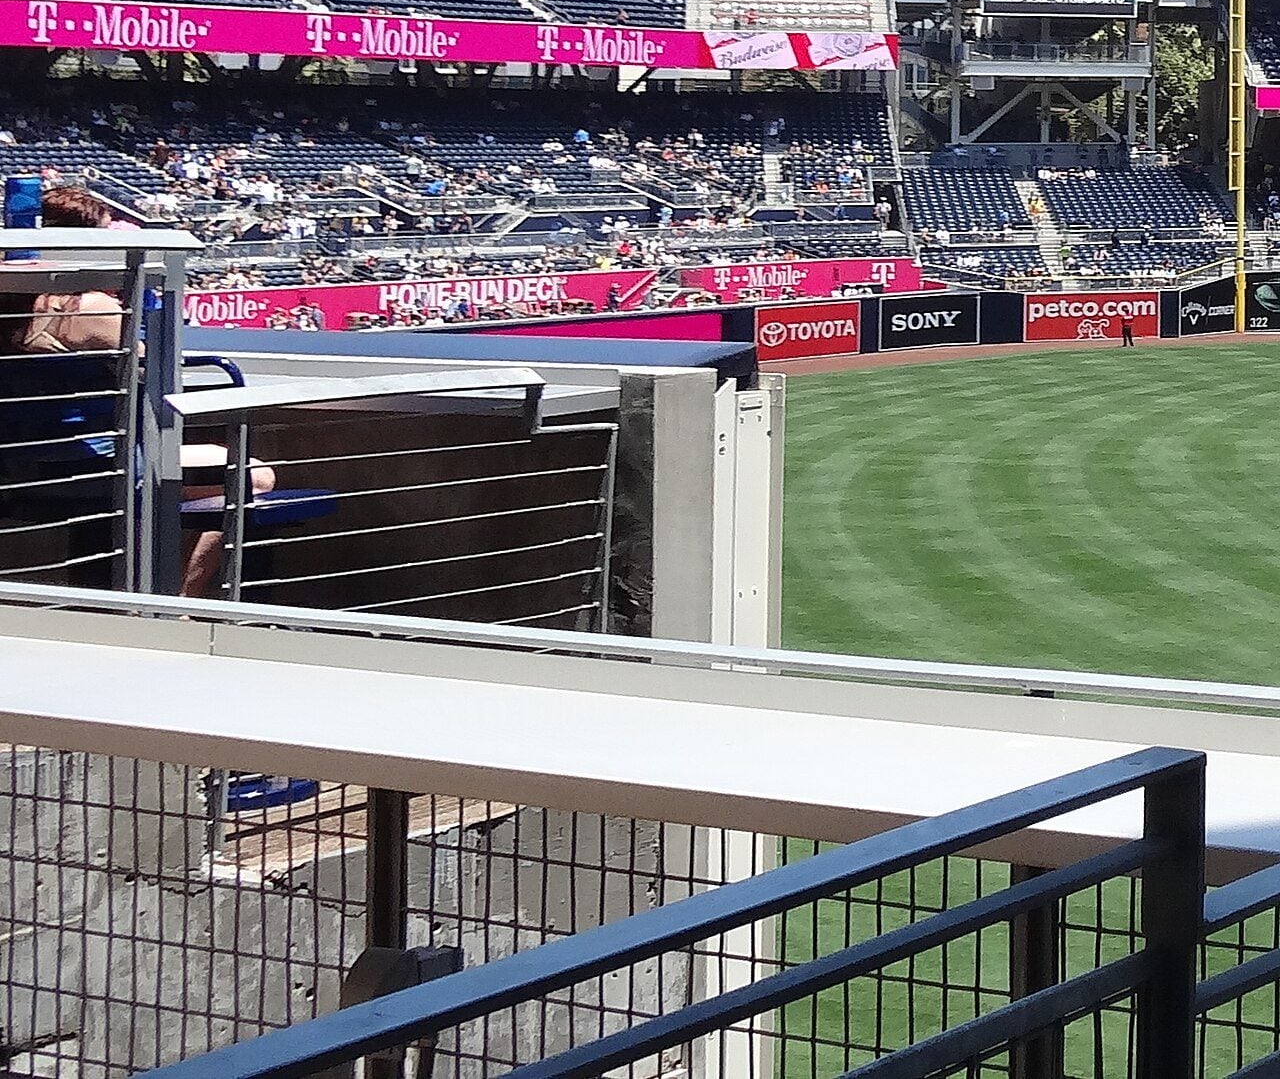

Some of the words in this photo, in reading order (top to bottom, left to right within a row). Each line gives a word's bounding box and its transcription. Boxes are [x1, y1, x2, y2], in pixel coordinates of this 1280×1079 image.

[507, 276, 569, 301] DECK
[891, 311, 961, 332] SONY
[1028, 300, 1156, 322] petco.com
[787, 319, 856, 339] TOYOTA
[1250, 317, 1268, 328] 322
